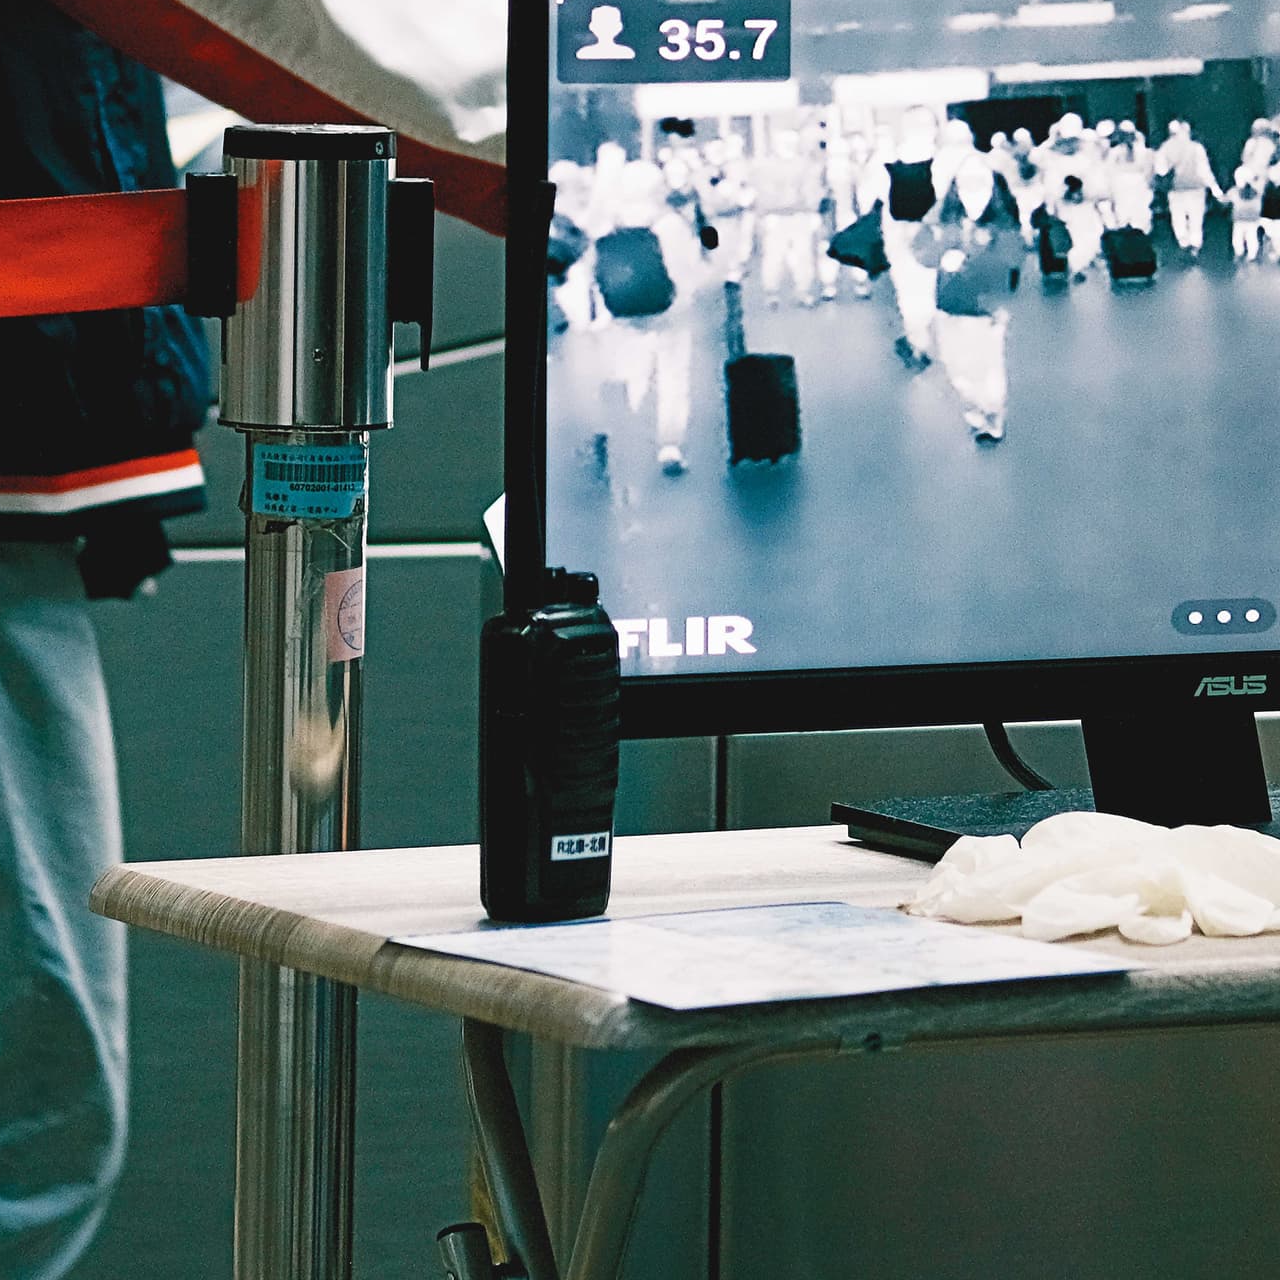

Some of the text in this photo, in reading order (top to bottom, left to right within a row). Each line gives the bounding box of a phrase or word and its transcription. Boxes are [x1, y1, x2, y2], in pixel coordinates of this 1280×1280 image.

[659, 19, 779, 61] 35.7
[611, 615, 757, 658] FLIR
[1193, 674, 1267, 697] ASUS
